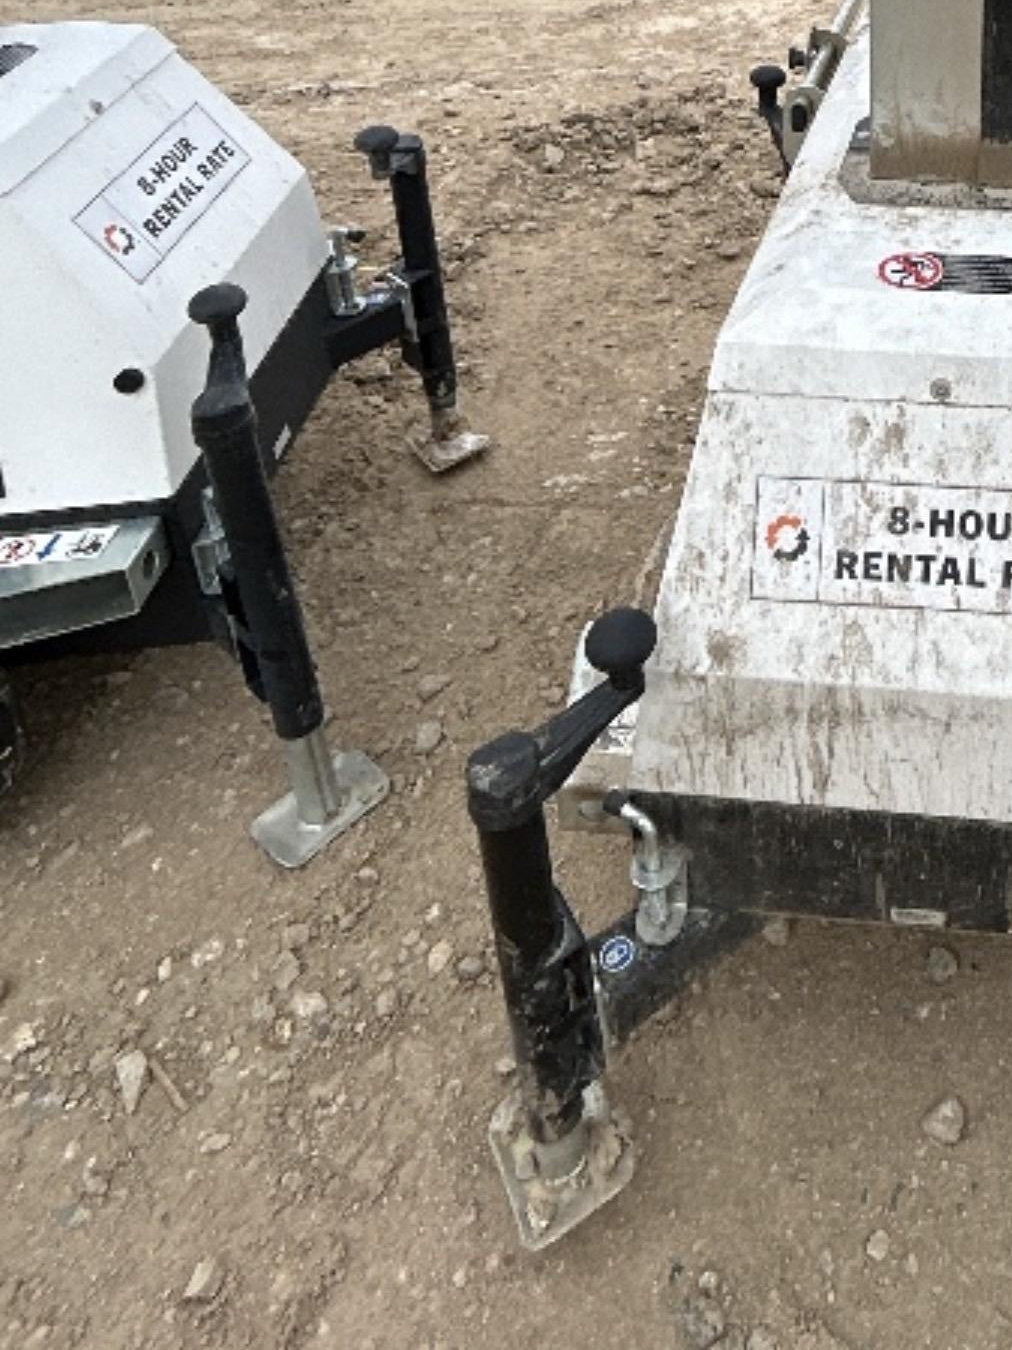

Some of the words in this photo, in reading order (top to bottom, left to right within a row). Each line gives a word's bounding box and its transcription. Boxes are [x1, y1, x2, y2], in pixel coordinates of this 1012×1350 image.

[137, 137, 199, 196] 8-HOUR
[143, 176, 205, 238] RENTAL
[197, 140, 235, 181] RATE
[833, 551, 987, 589] RENTAL
